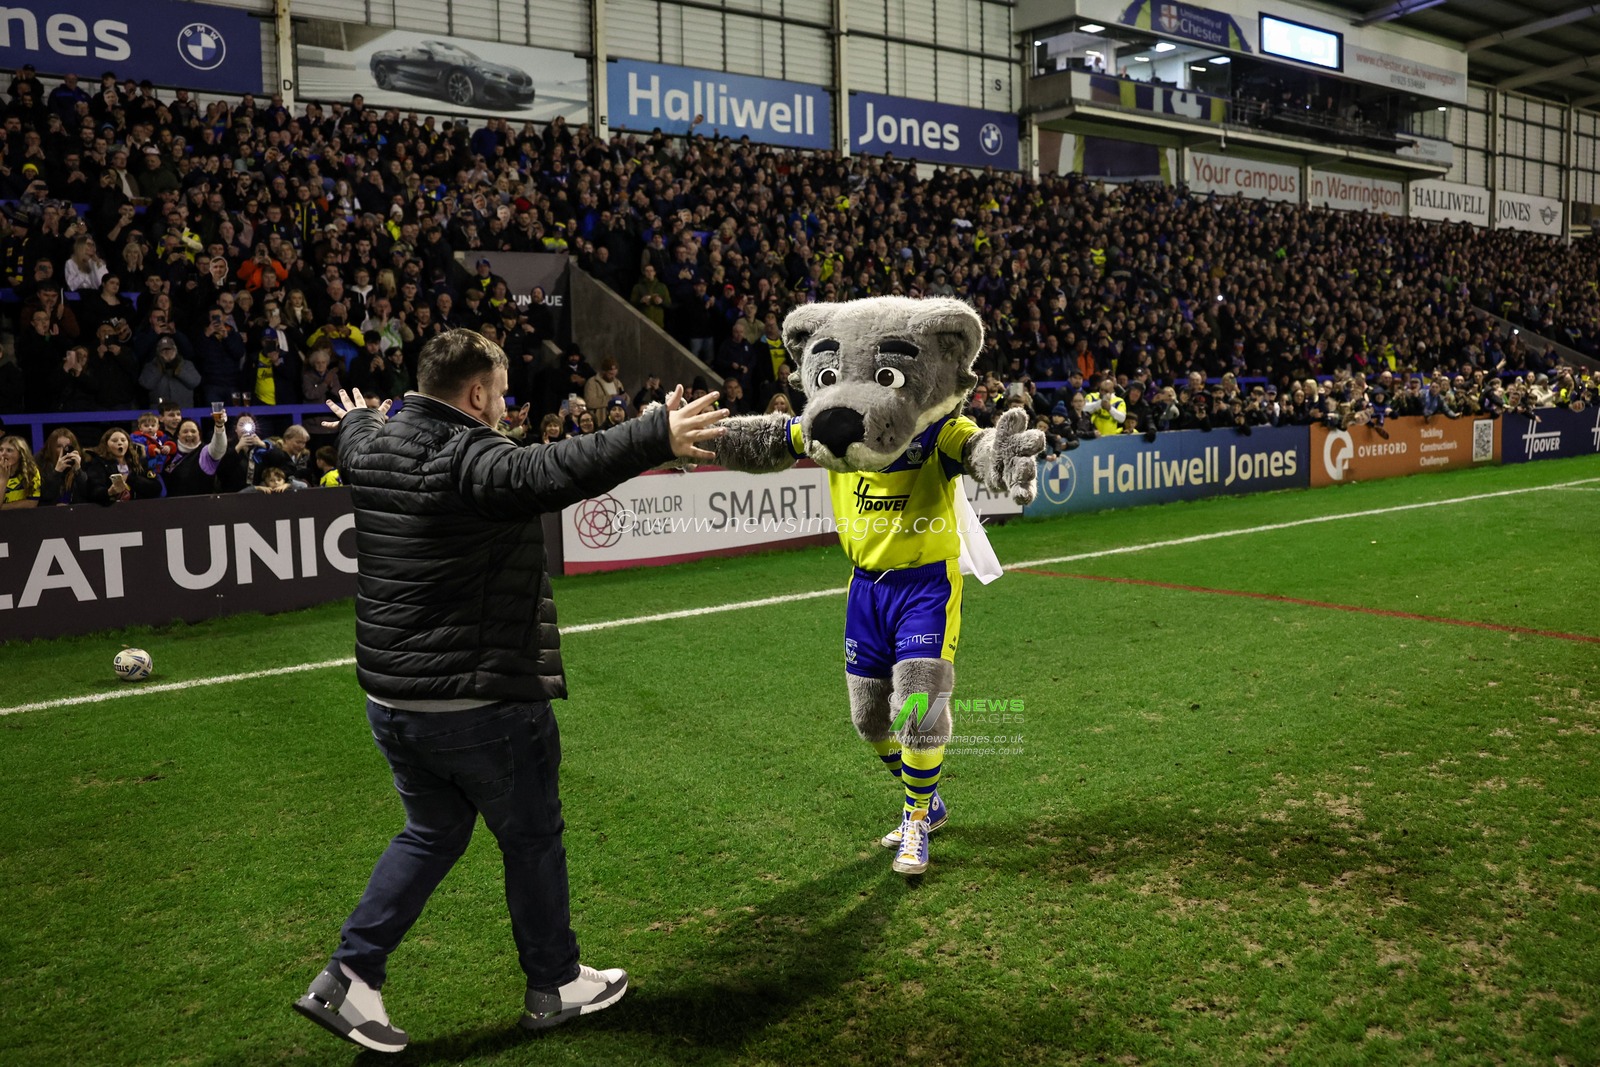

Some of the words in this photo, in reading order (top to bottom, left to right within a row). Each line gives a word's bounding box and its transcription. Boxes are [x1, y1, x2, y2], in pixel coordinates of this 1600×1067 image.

[1180, 8, 1214, 29] University
[1180, 18, 1223, 43] Chester
[283, 79, 292, 91] D
[994, 78, 1002, 91] S
[628, 72, 814, 136] Halliwell
[600, 115, 607, 126] E
[859, 102, 960, 152] Jones
[1192, 156, 1231, 185] Your
[1234, 168, 1296, 197] campus
[1311, 174, 1323, 197] in
[1326, 175, 1401, 210] Warrington
[1415, 187, 1485, 216] HALLIWELL
[1496, 199, 1531, 223] JONES
[512, 294, 563, 307] UNUE
[1420, 427, 1444, 440] Tackling
[1522, 419, 1561, 460] HOOVER
[1358, 441, 1408, 458] OVERFORD
[1093, 446, 1219, 495] Halliwell
[1225, 445, 1297, 487] Jones
[1420, 455, 1450, 467] Challenges
[630, 495, 683, 515] TAYLOR
[708, 484, 821, 530] SMART.
[632, 517, 672, 537] ROSE
